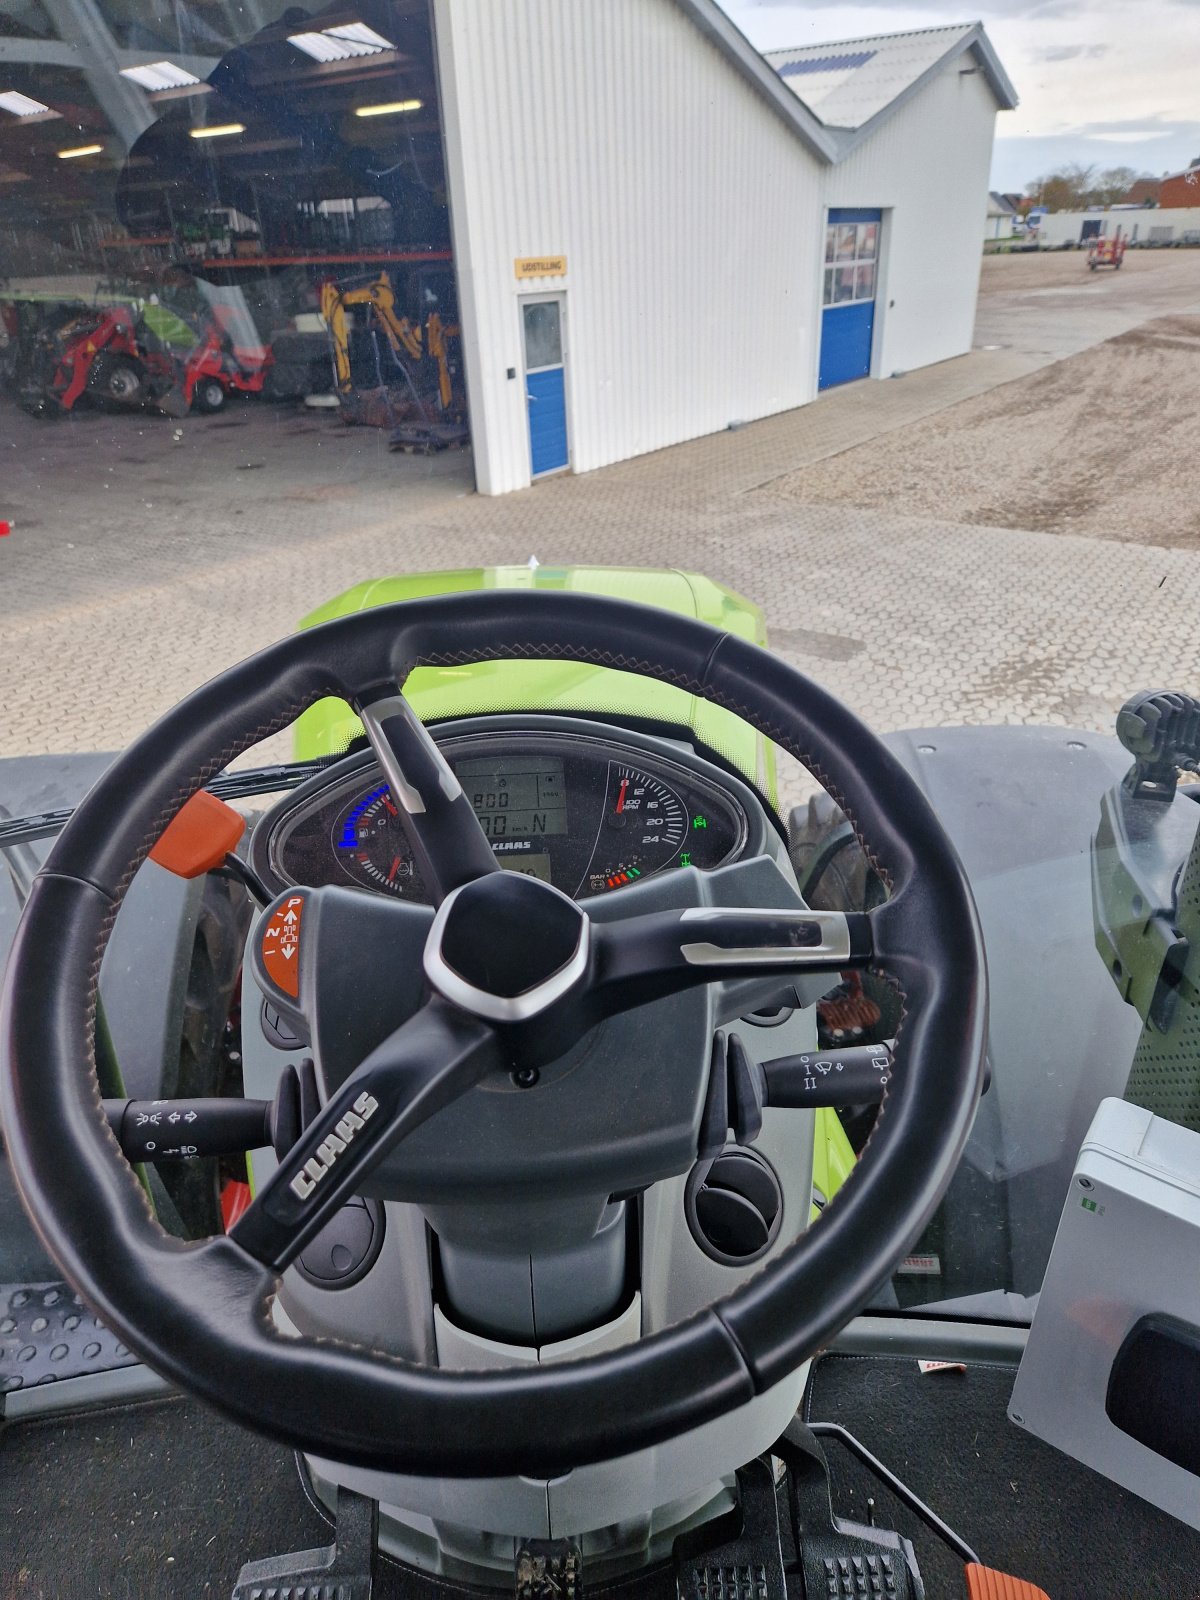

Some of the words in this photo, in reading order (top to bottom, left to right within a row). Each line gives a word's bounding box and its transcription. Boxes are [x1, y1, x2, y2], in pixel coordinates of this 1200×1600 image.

[633, 788, 645, 796] 12
[474, 793, 508, 808] 800
[646, 801, 658, 809] 16
[532, 814, 547, 832] N
[646, 818, 664, 826] 20
[641, 836, 660, 844] 24
[491, 841, 532, 851] CLAAS
[287, 898, 302, 908] P
[265, 927, 281, 938] N
[290, 1091, 379, 1201] CLAAS
